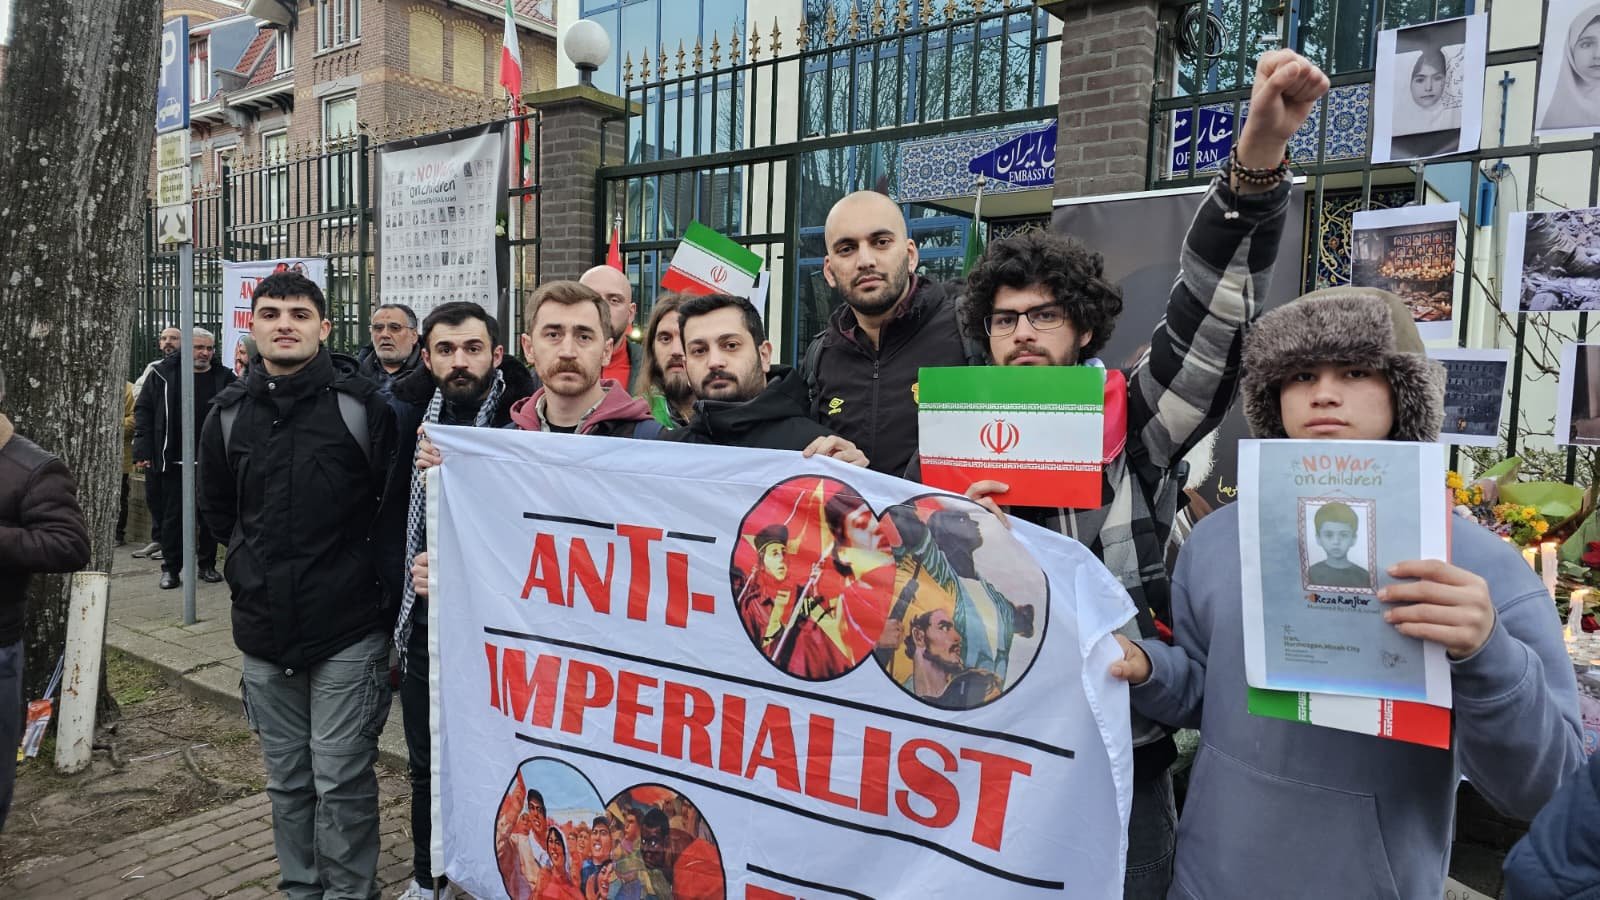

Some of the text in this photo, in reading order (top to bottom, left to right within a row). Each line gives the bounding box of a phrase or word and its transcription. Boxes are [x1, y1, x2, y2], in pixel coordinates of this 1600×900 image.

[161, 31, 177, 87] P
[997, 134, 1043, 174] ایران
[1176, 149, 1218, 166] OF RAN
[1009, 166, 1056, 183] EMBASSY O
[421, 180, 456, 195] children
[1302, 454, 1375, 473] NO War
[1294, 472, 1382, 487] on children
[521, 524, 715, 628] ANTI-
[484, 642, 1032, 852] IMPERIALIST
